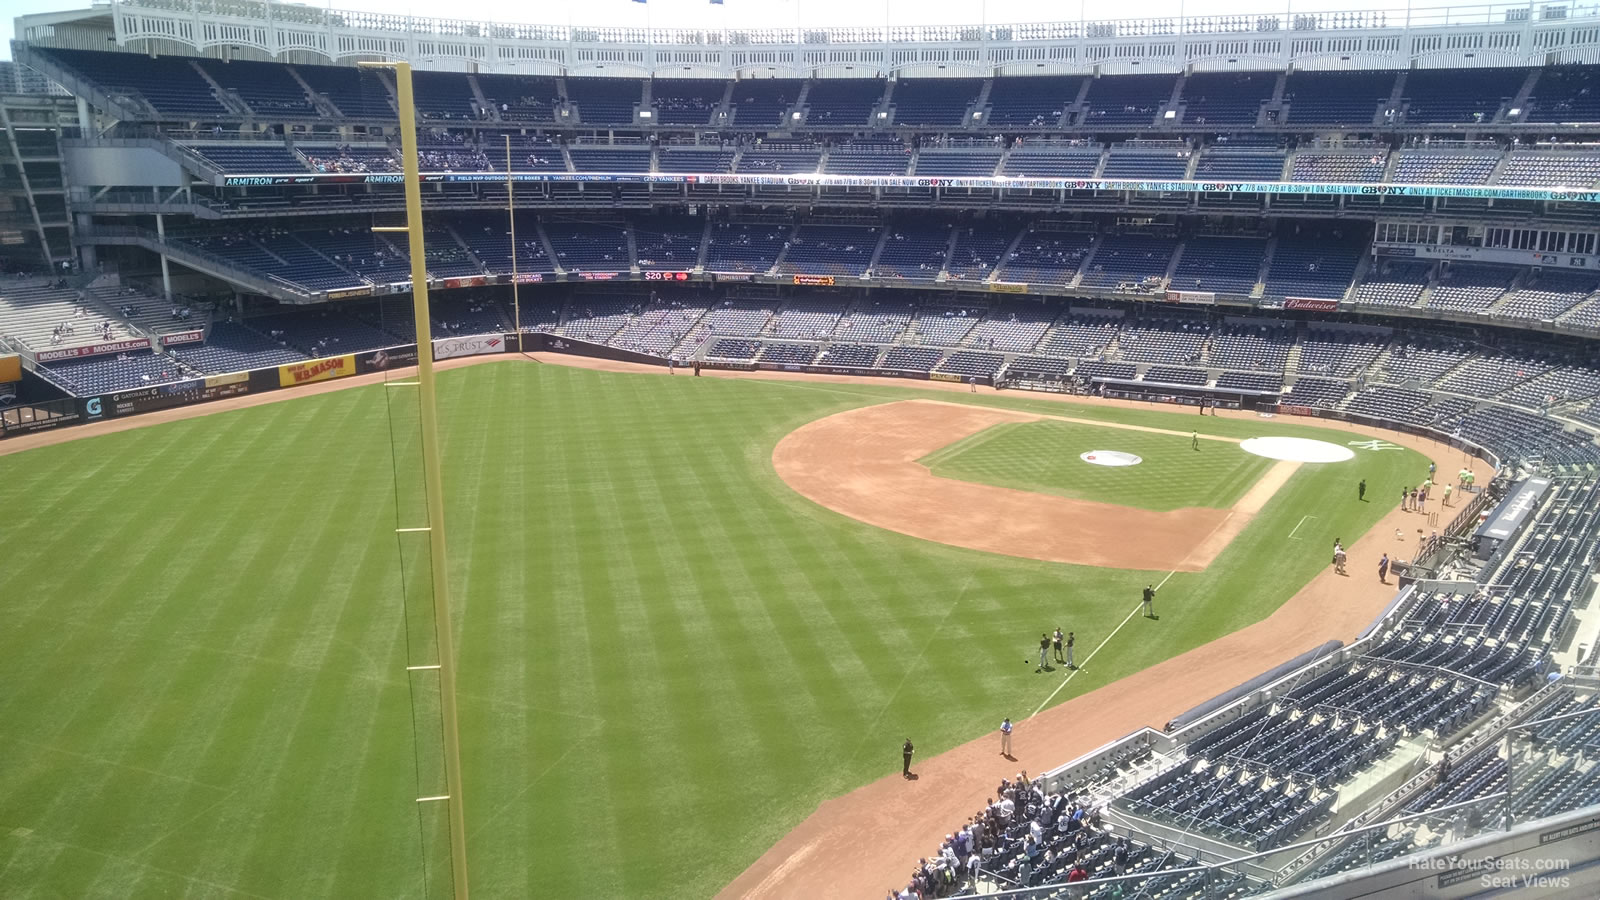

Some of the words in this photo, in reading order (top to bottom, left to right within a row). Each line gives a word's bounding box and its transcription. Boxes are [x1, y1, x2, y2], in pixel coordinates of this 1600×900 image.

[226, 177, 272, 185] ARMITRON
[1435, 189, 1548, 199] TICKETMASTER.COM/GARTHBROOKS
[1287, 299, 1336, 309] Budweiser
[166, 333, 199, 343] MODELL'S
[39, 349, 78, 360] MODELL'S
[93, 340, 148, 353] MODELLS.com
[454, 341, 482, 352] TRUST
[86, 397, 102, 414] G
